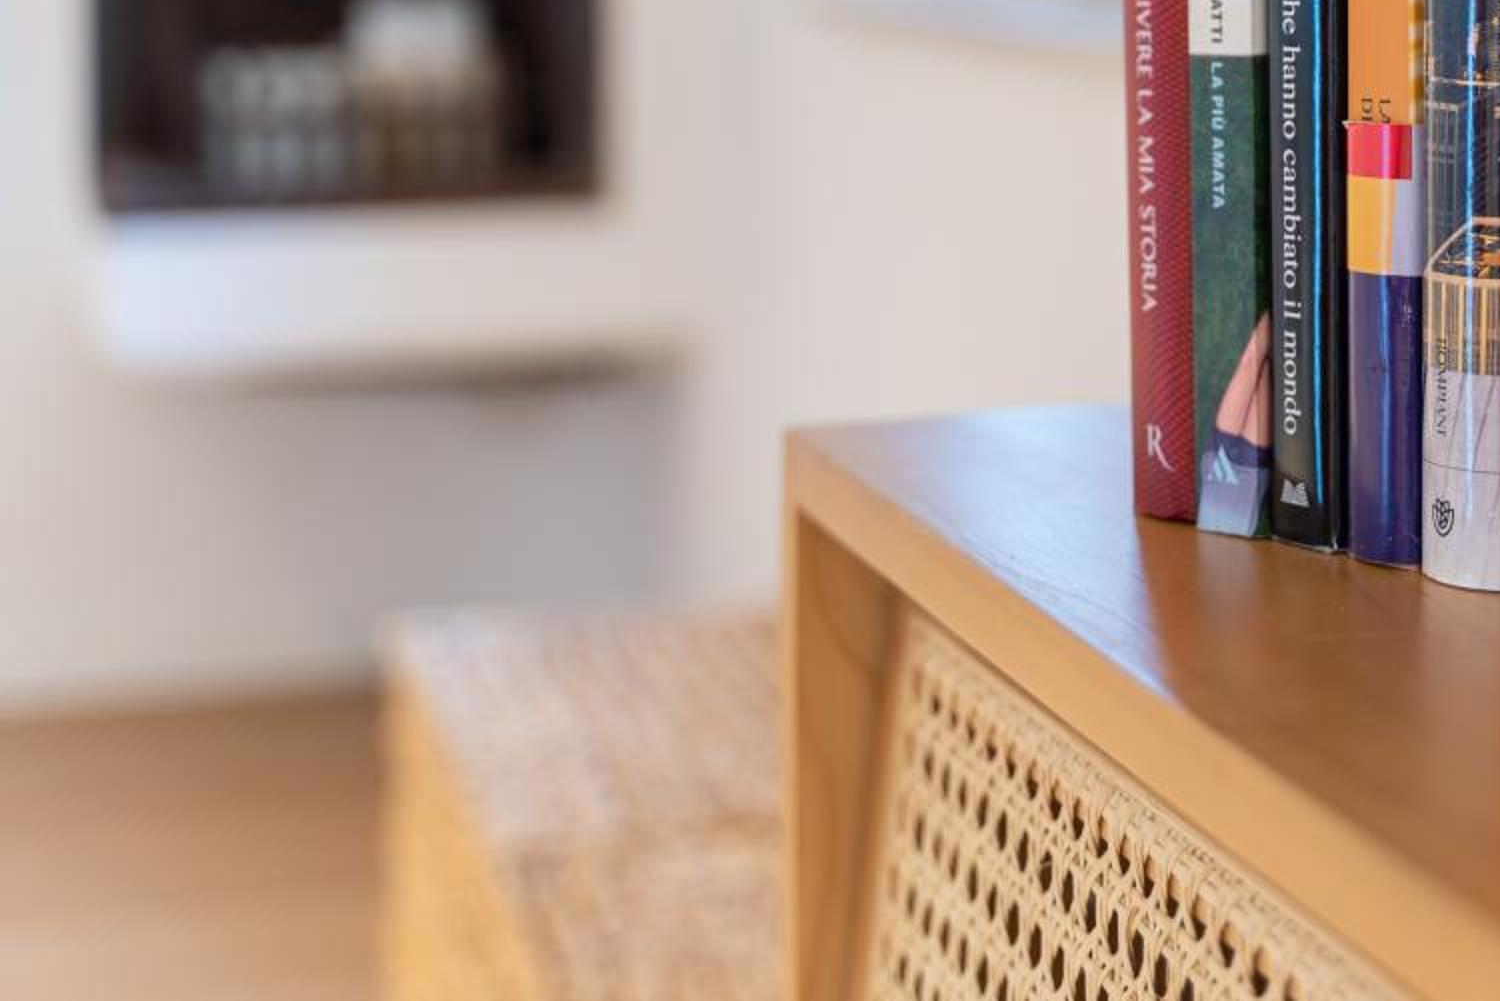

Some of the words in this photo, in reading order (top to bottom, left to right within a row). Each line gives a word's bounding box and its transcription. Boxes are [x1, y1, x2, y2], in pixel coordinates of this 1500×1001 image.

[1136, 89, 1154, 126] LA
[1211, 61, 1224, 88] LA
[1281, 43, 1302, 139] hanno
[1137, 137, 1155, 195] MIA
[1211, 136, 1225, 209] AMATA
[1282, 150, 1303, 289] cambiato
[1139, 206, 1158, 312] STORIA
[1282, 303, 1303, 324] il
[1282, 330, 1303, 436] mondo
